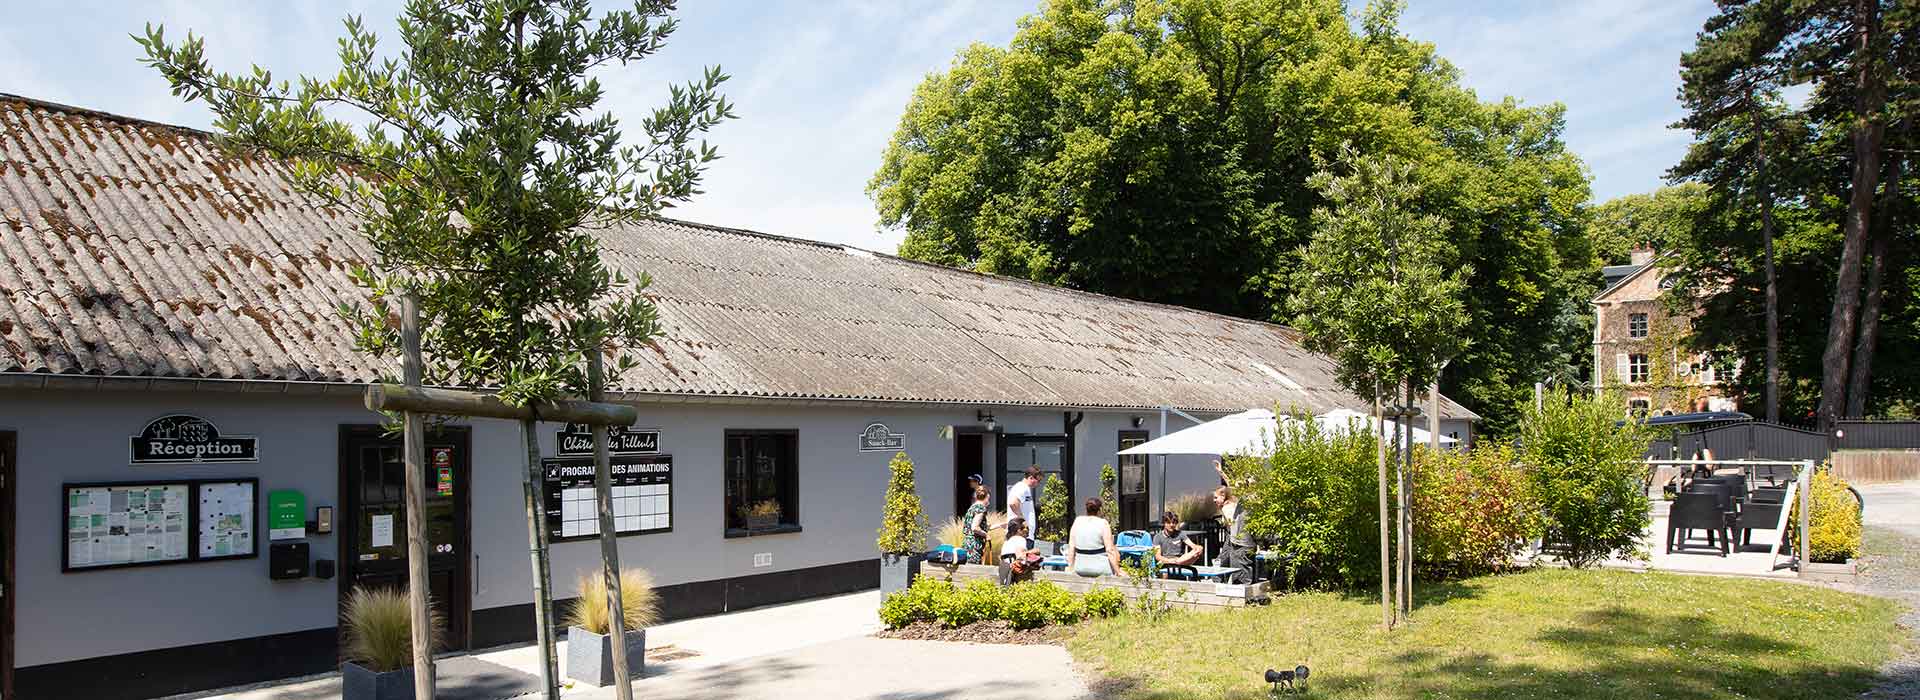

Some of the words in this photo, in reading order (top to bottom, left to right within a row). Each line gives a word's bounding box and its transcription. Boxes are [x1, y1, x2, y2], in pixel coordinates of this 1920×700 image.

[620, 435, 655, 449] Tilleuls
[149, 441, 243, 458] Réception
[561, 465, 596, 476] PROGRA
[611, 464, 626, 474] DES
[627, 462, 670, 474] ANIMATIONS
